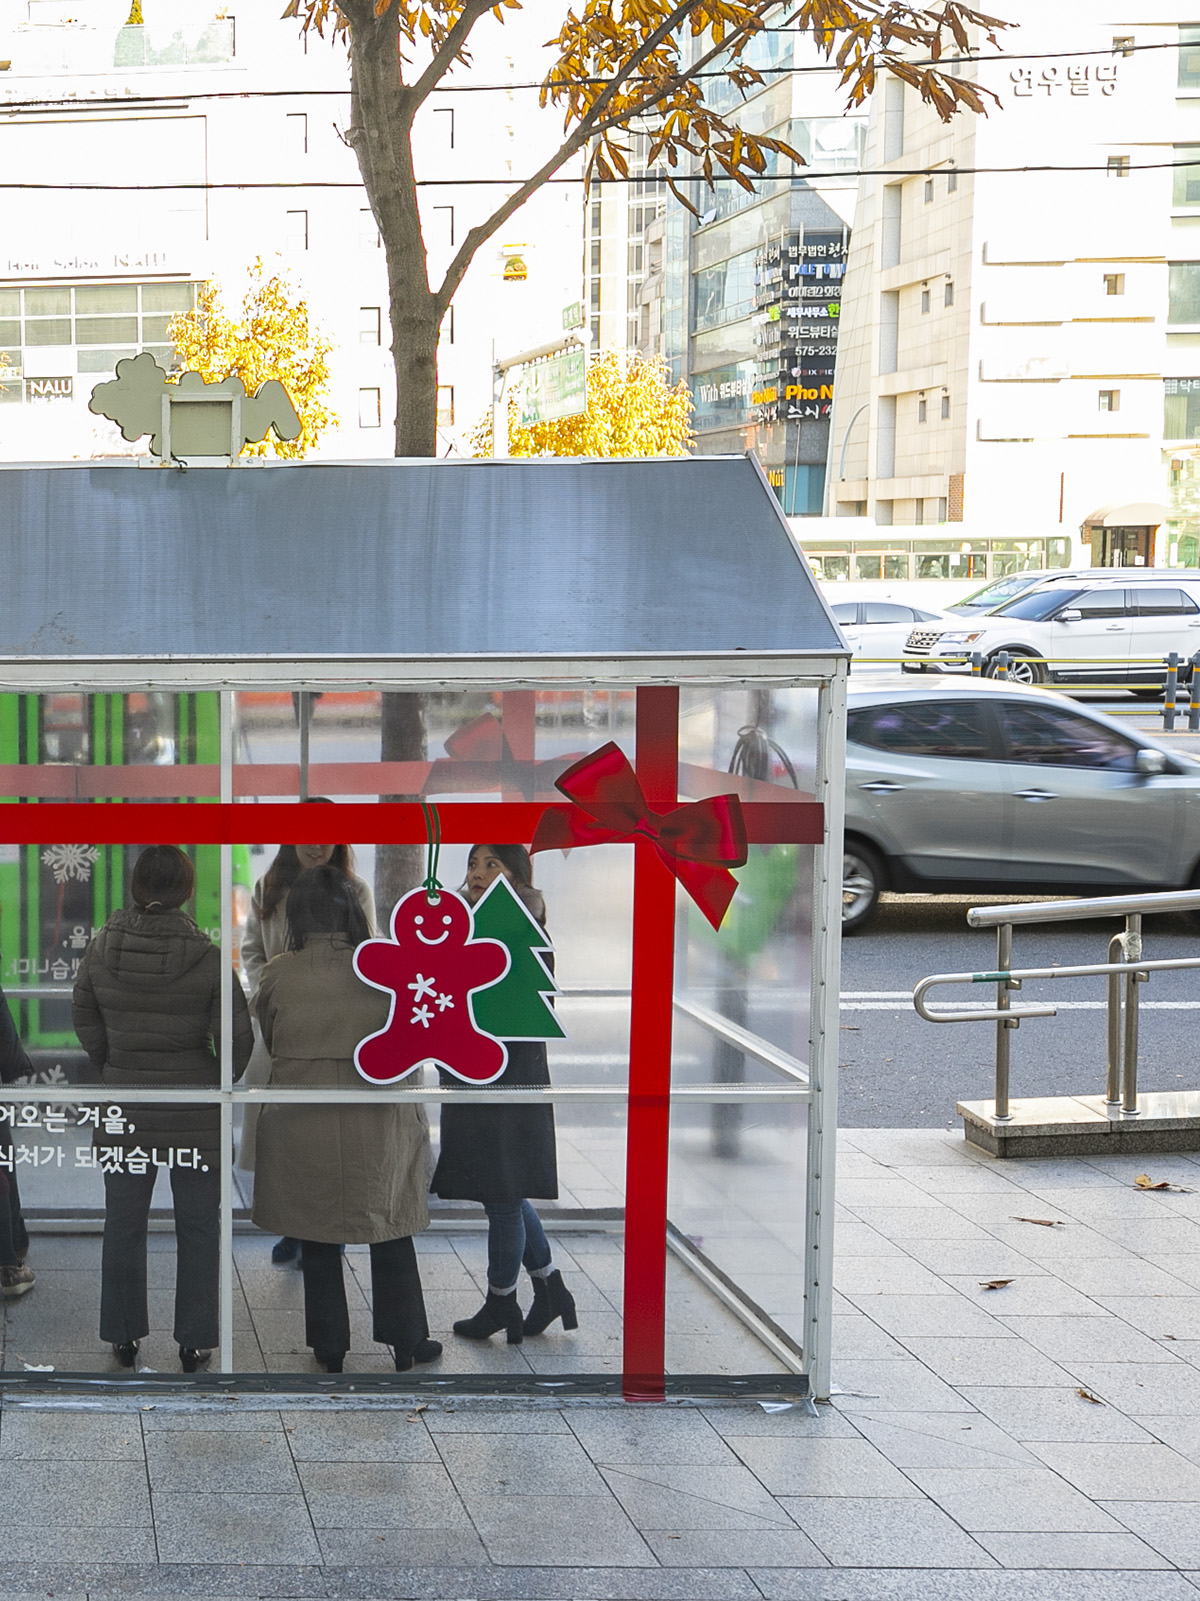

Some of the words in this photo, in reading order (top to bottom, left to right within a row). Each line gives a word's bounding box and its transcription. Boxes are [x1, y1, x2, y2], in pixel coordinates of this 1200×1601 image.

[1009, 65, 1118, 97] 연우빌딩
[788, 245, 827, 258] 법무법인
[30, 379, 72, 395] NALU
[699, 383, 719, 403] With
[785, 384, 819, 401] Pho
[77, 1106, 137, 1135] 겨울,
[74, 1146, 210, 1175] 되겠습니다.
